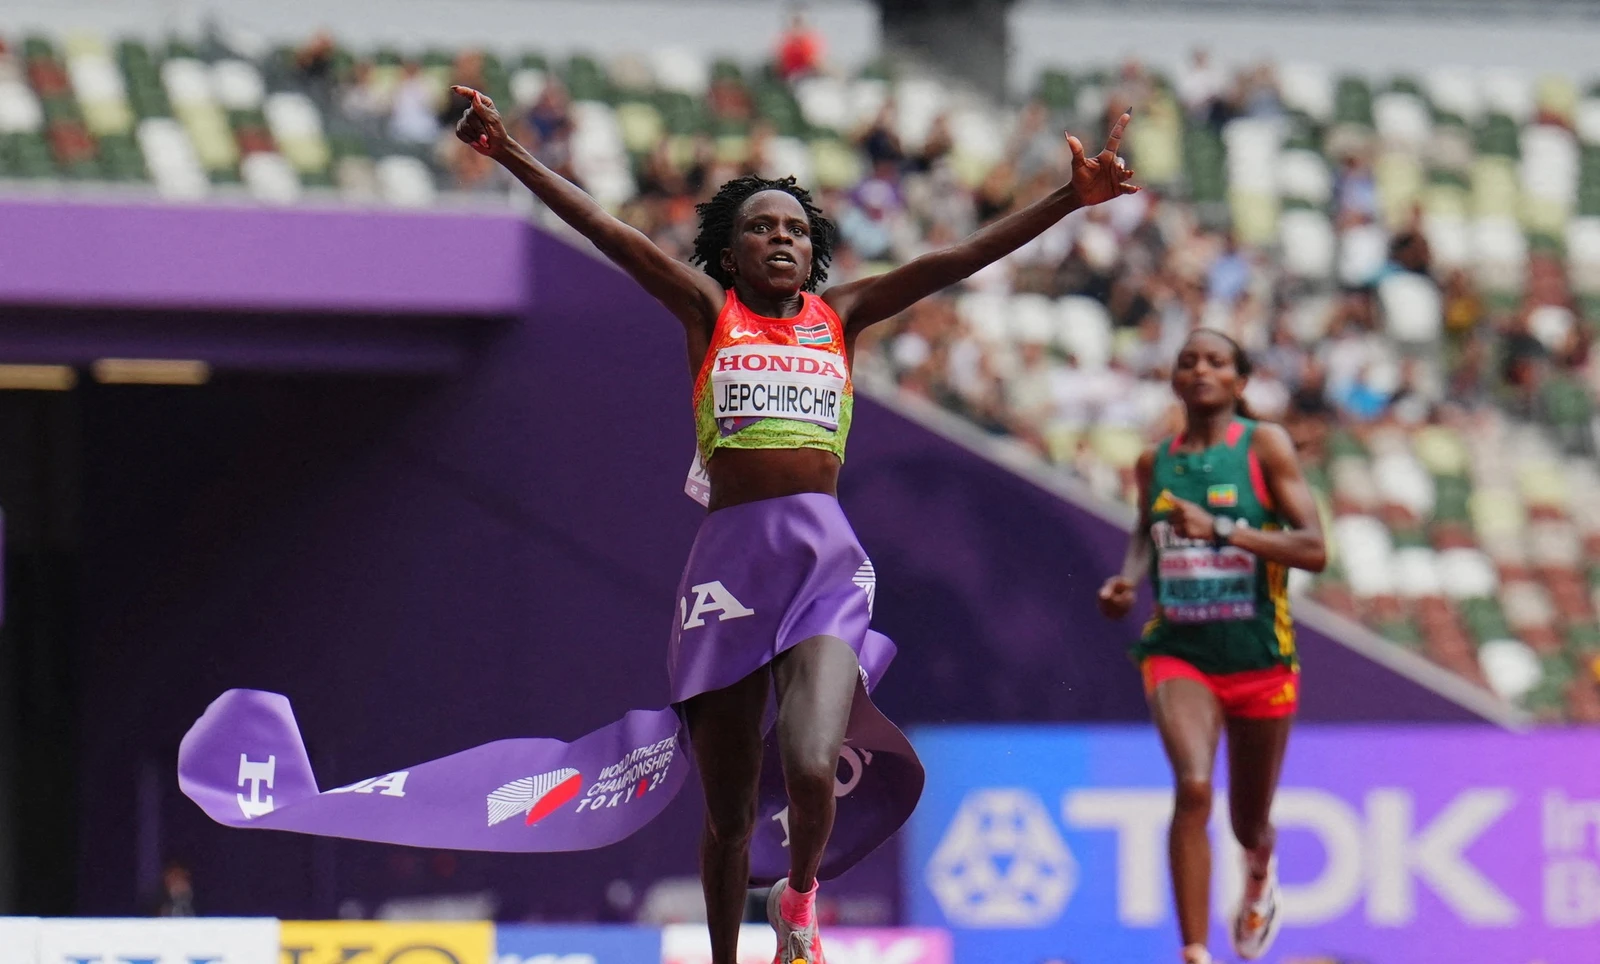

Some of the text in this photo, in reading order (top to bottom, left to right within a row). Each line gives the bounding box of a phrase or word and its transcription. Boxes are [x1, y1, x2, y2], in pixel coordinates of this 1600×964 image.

[716, 354, 843, 379] HONDA
[718, 383, 836, 418] JEPCHIRCHIR
[598, 753, 630, 781] WORLD
[1063, 789, 1521, 926] TDK
